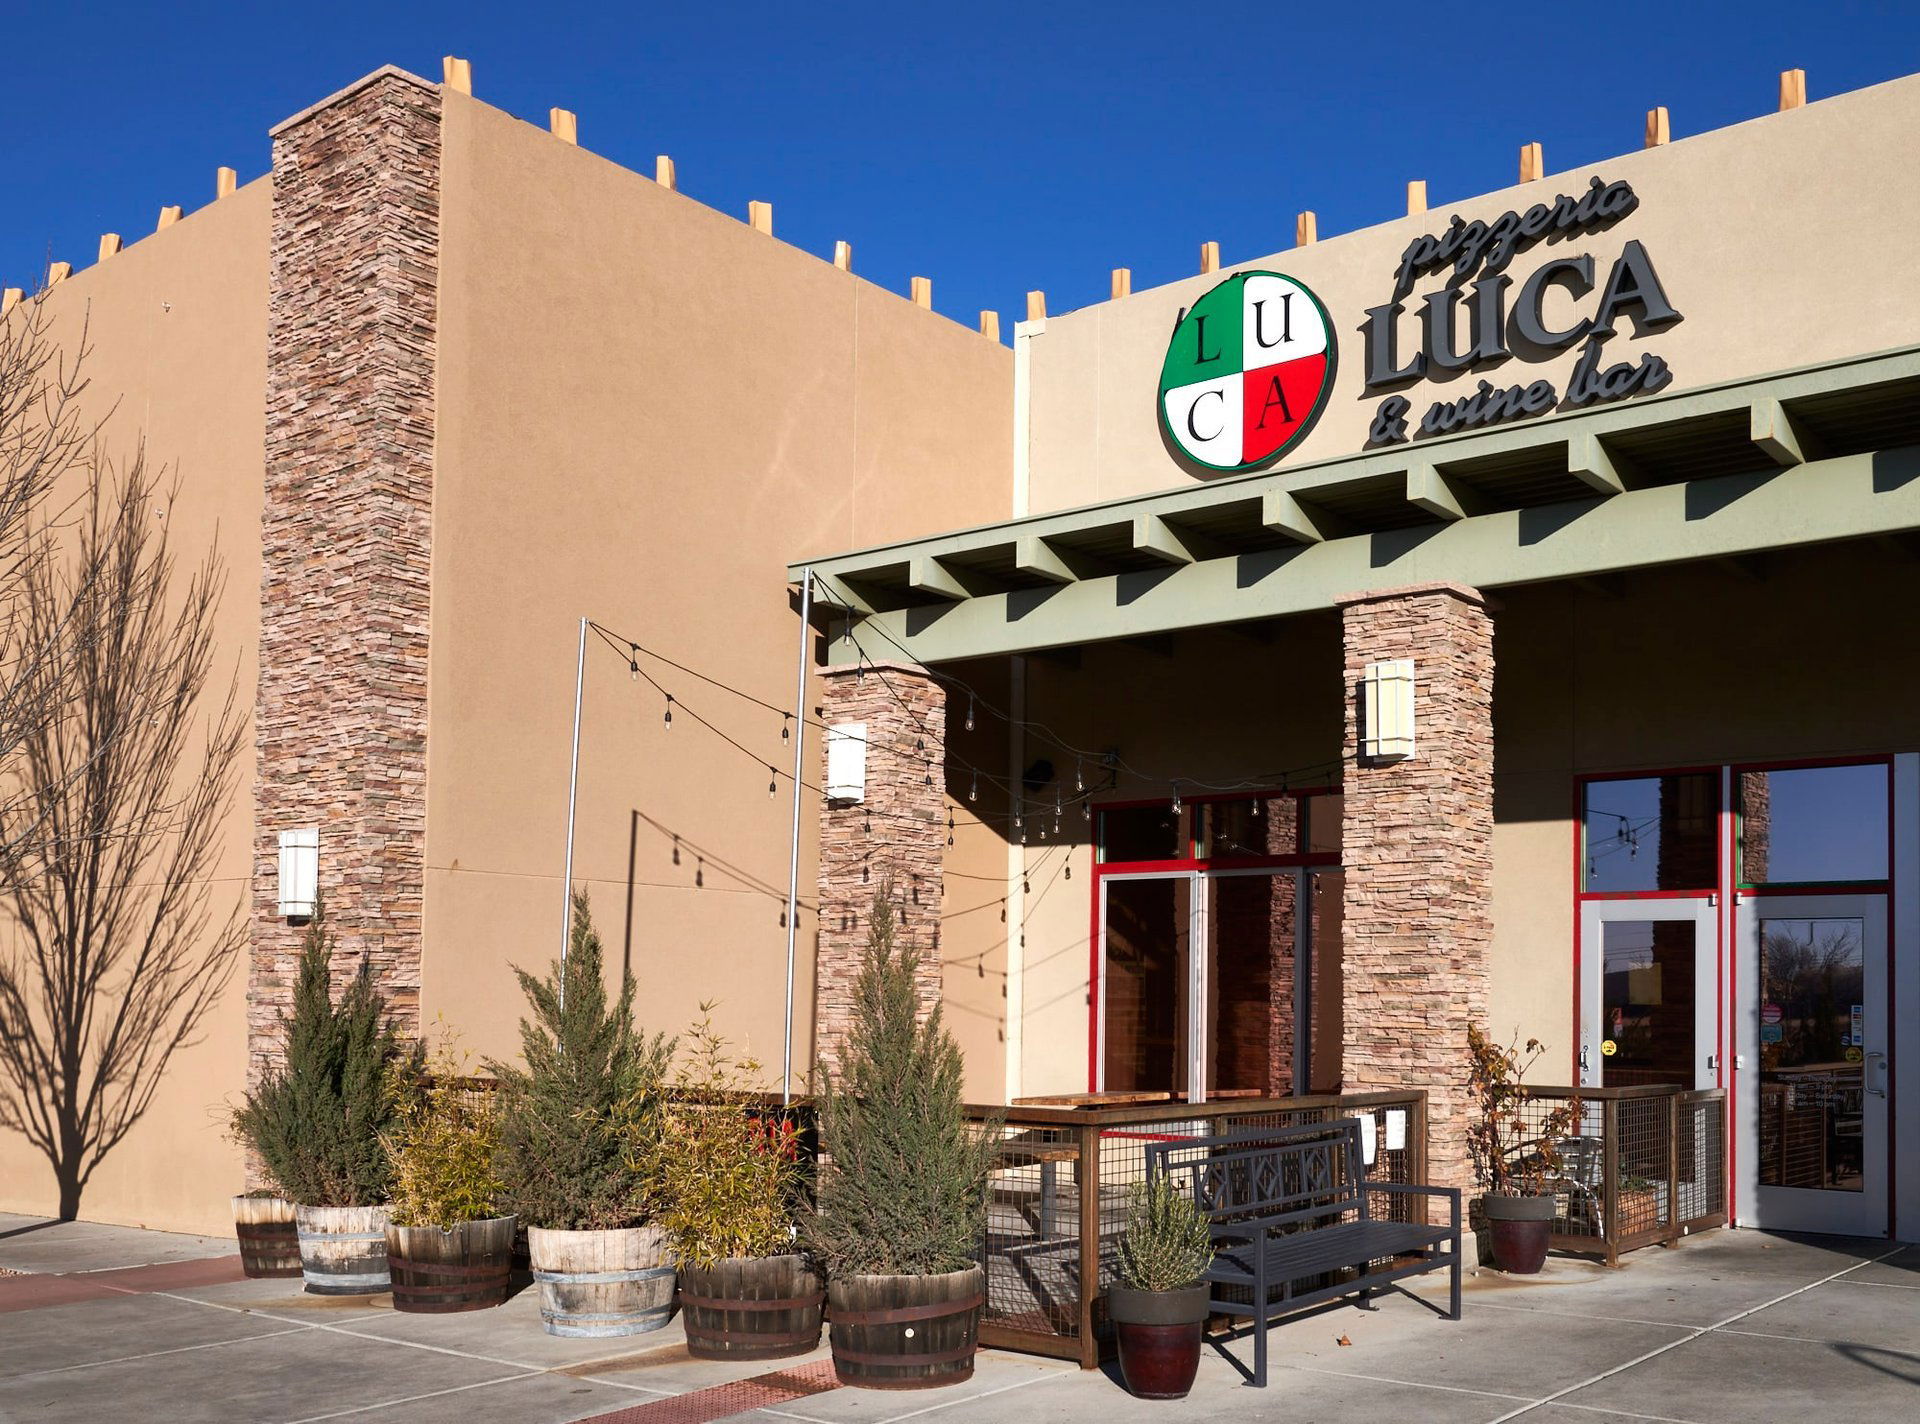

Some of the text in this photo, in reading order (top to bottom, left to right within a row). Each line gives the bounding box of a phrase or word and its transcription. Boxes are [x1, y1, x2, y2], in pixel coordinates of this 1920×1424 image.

[1401, 176, 1639, 291] pizzeria
[1364, 240, 1683, 388] LUCA
[1369, 340, 1673, 444] & wine bar
